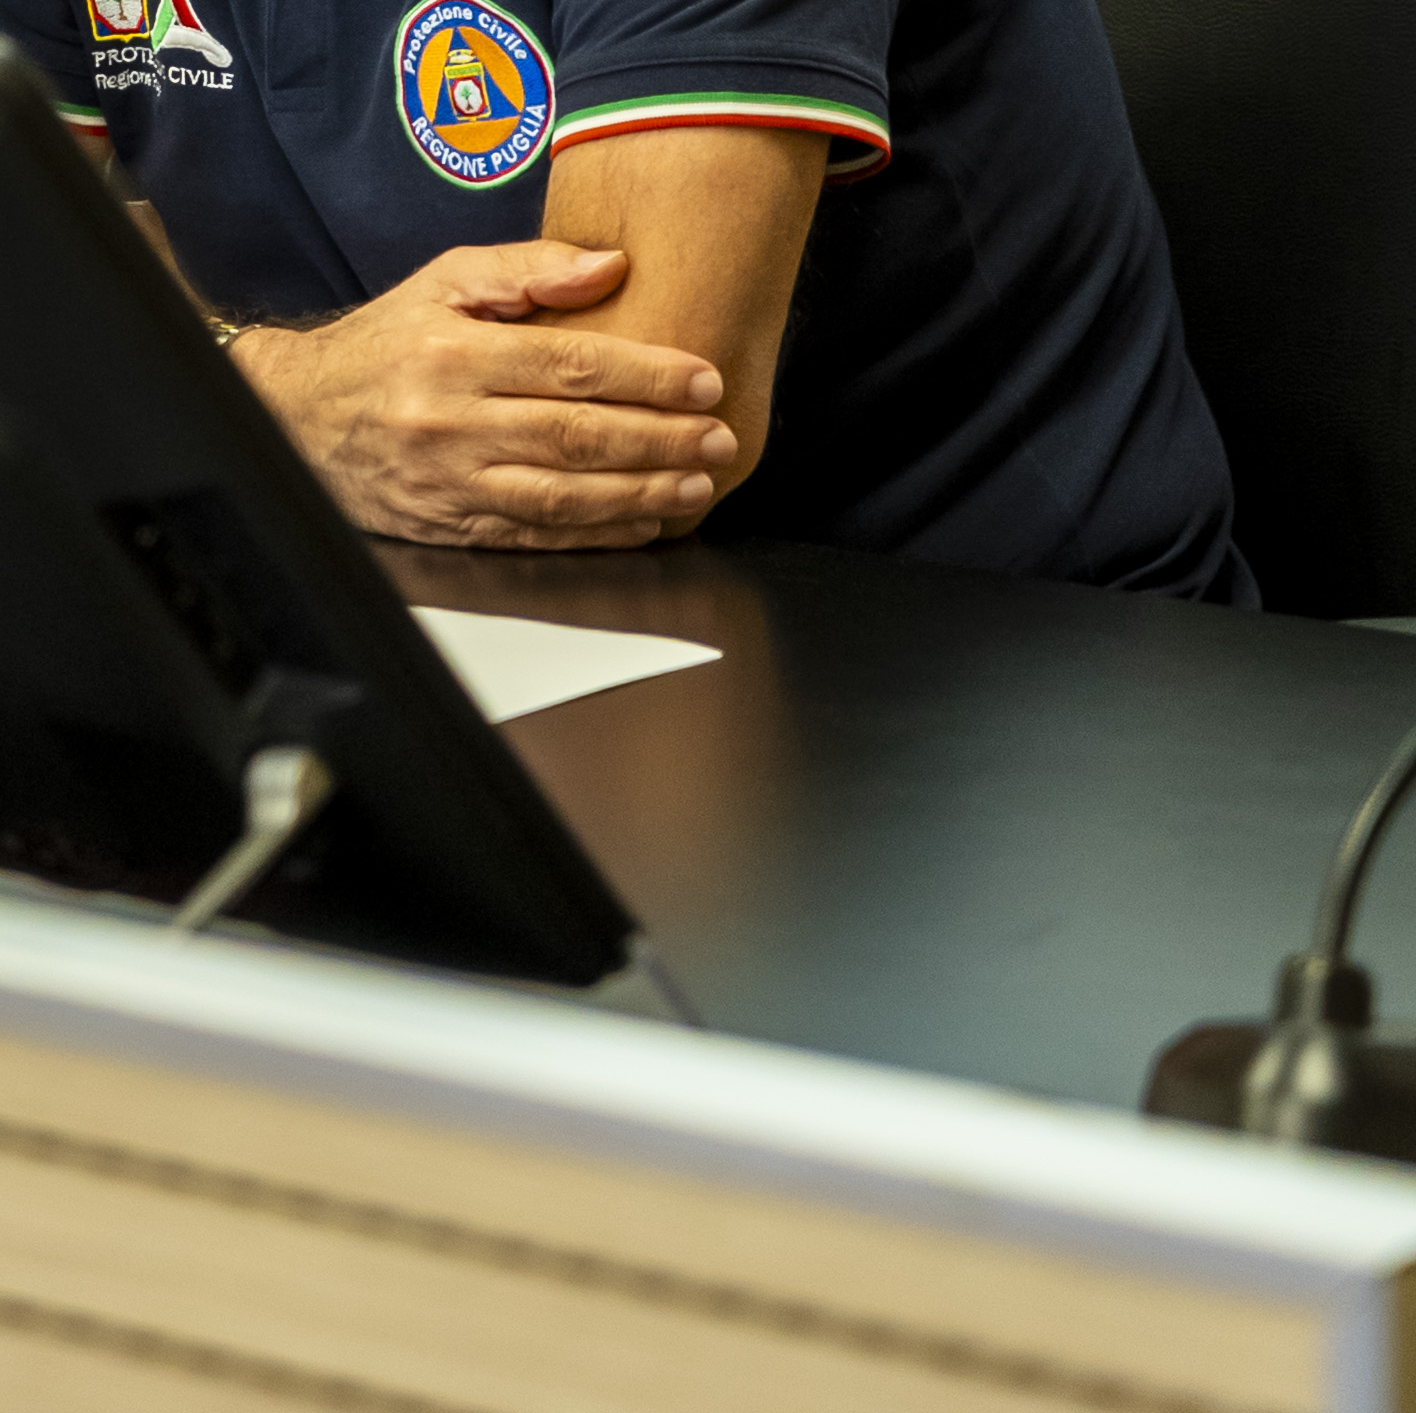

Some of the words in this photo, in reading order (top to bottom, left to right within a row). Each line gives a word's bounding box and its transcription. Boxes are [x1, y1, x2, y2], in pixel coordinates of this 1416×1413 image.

[403, 6, 473, 75] Protezione
[477, 13, 528, 60] Civile
[168, 66, 234, 90] CIVILE
[412, 116, 488, 178] REGIONE
[491, 103, 546, 173] PUGLIA
